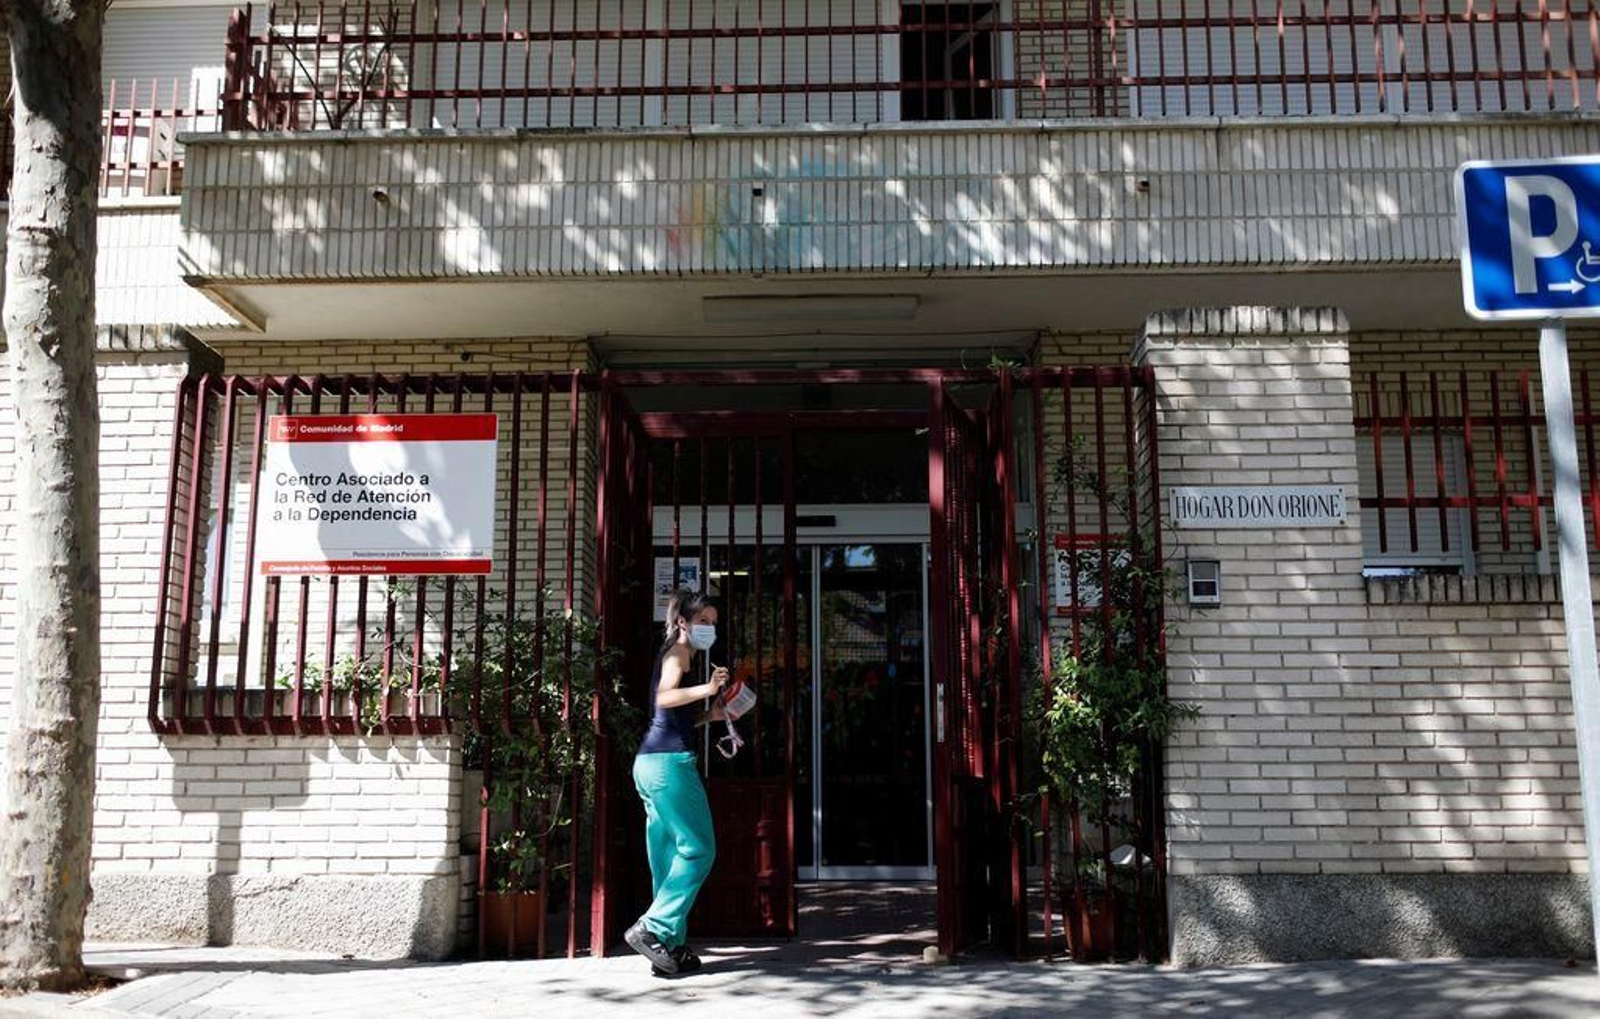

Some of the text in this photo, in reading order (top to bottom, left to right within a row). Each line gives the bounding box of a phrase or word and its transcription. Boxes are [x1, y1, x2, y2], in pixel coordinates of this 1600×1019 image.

[1504, 174, 1579, 295] P
[300, 425, 353, 433] Comunidad
[275, 471, 429, 486] Centro Asociado a
[274, 489, 430, 503] la Red de Atención
[1175, 494, 1341, 519] HOGAR DON ORIONE
[272, 507, 417, 522] a la Dependencia
